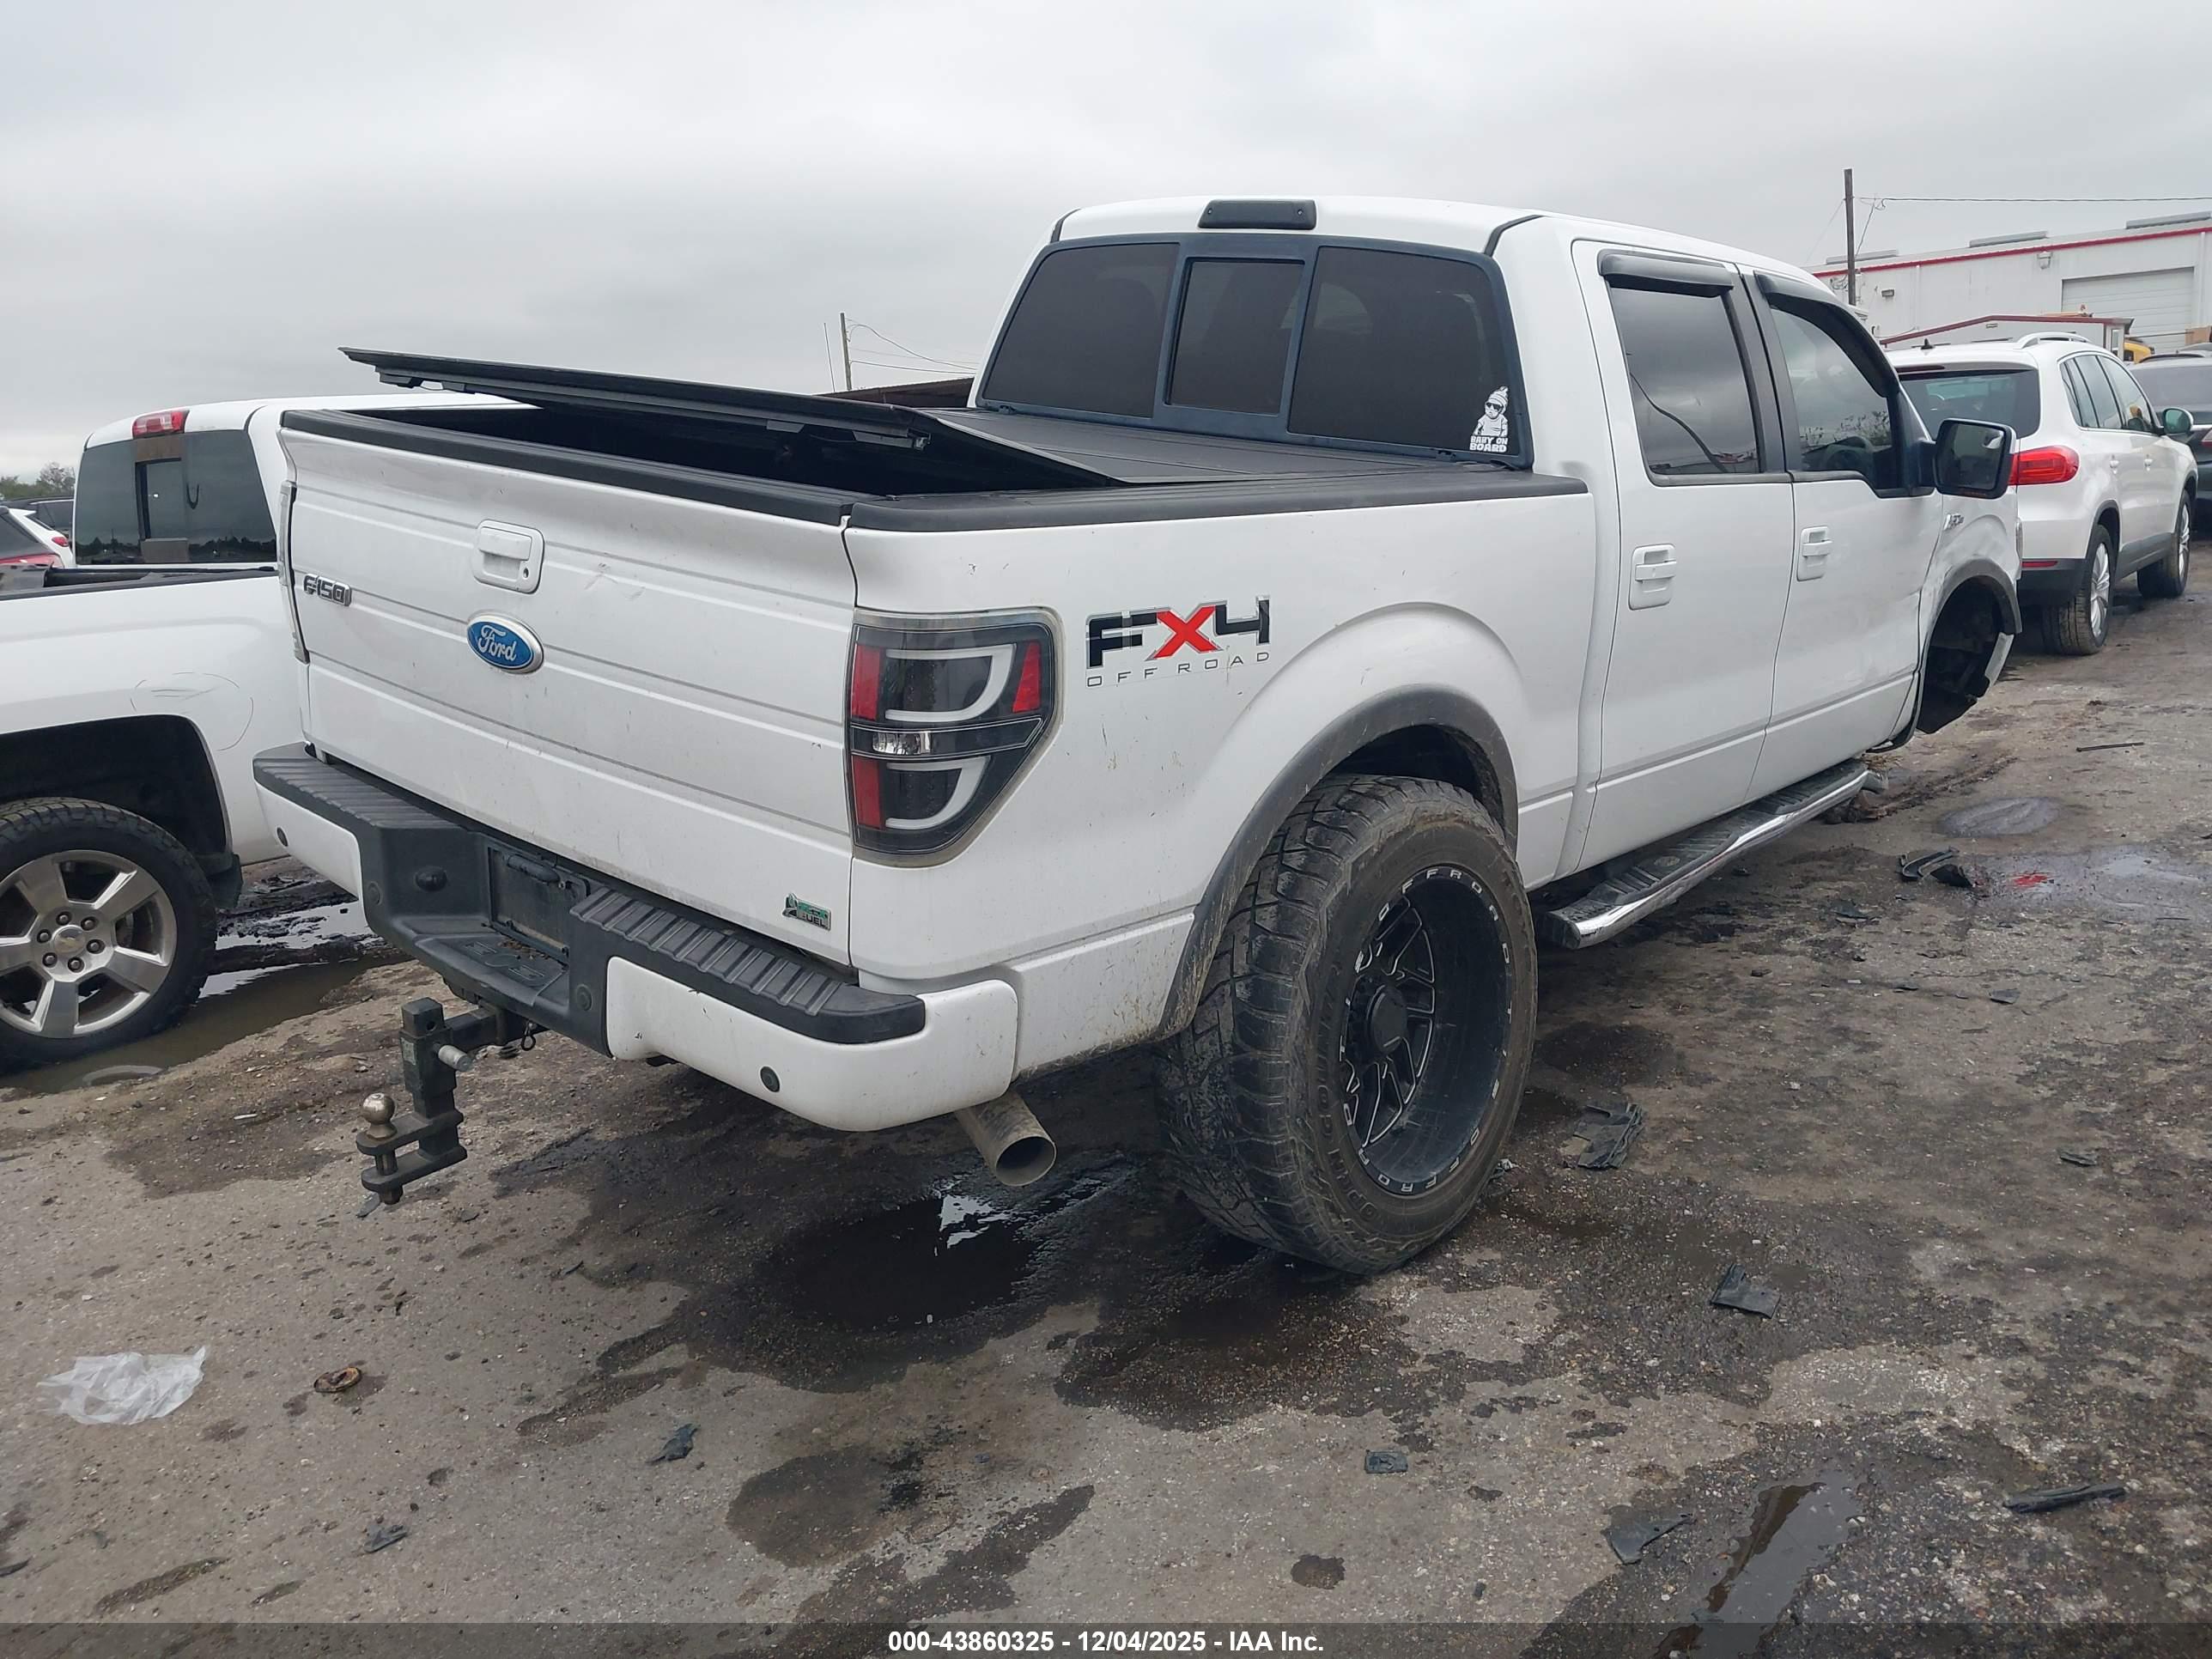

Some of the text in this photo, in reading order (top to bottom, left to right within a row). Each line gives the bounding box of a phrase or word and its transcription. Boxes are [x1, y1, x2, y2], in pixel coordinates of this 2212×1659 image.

[1469, 443, 1507, 453] BOARD
[1470, 435, 1494, 444] BABY
[477, 624, 517, 661] Ford
[1086, 595, 1270, 669] FX4
